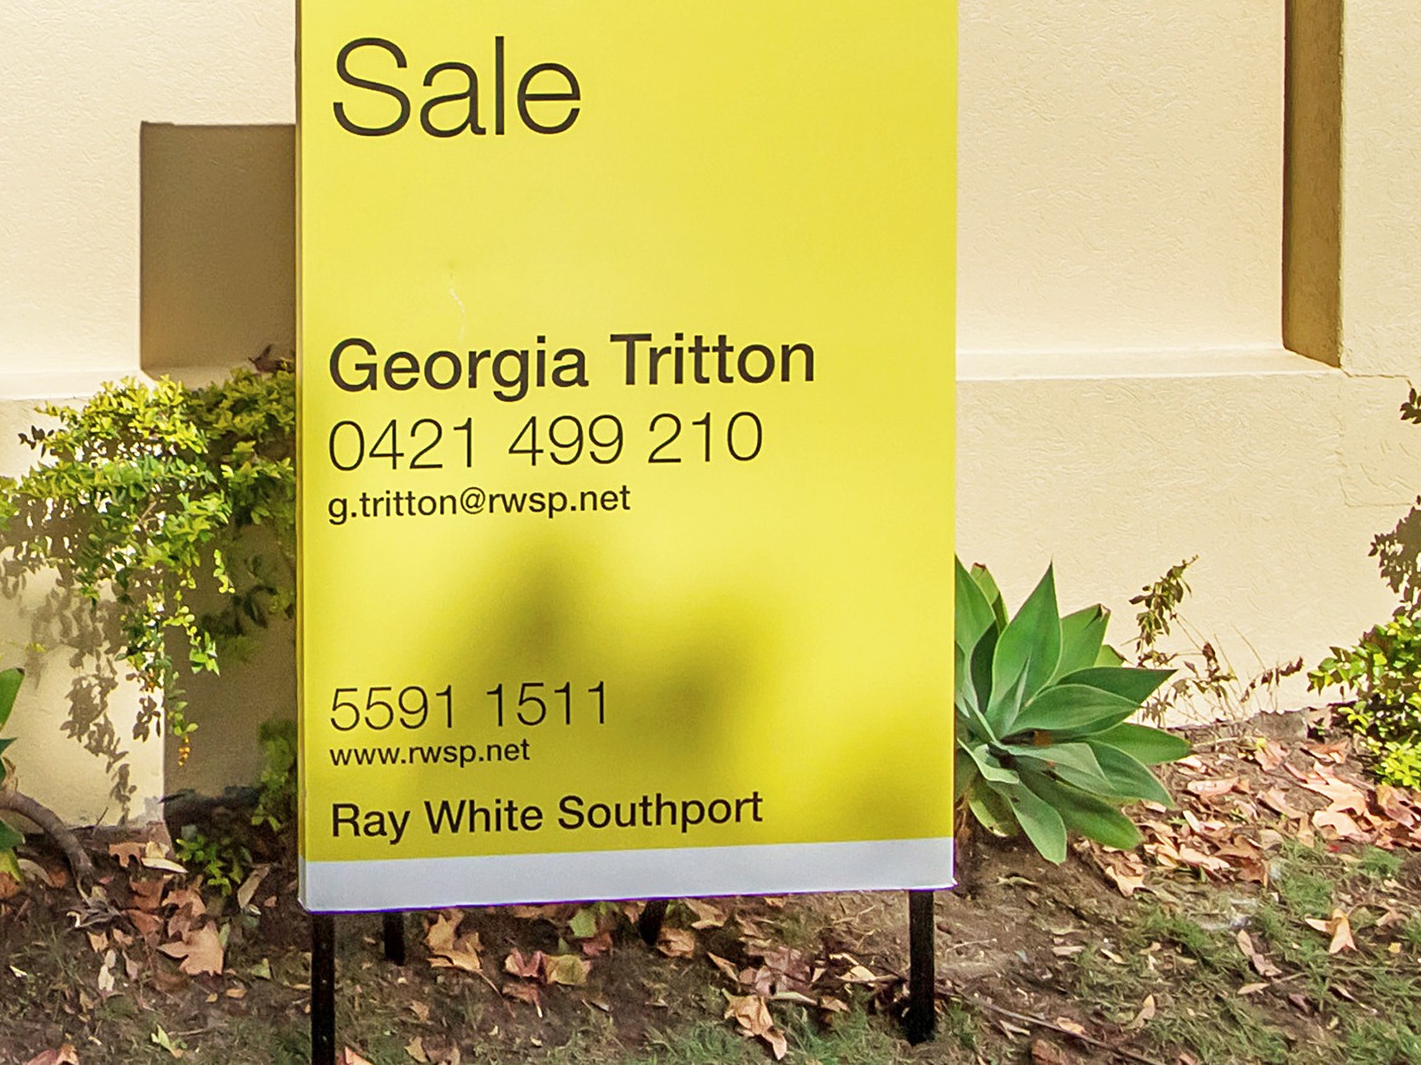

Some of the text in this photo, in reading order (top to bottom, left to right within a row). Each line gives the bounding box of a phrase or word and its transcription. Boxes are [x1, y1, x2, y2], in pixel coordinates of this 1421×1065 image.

[332, 35, 581, 138] Sale
[329, 332, 815, 403] Georgia Tritton
[328, 411, 763, 472] 0421 499 210
[328, 484, 631, 526] g.tritton@rwsp.net
[330, 680, 605, 732] 5591 1511
[329, 738, 531, 769] www.rwsp.net
[332, 791, 764, 846] Ray White Southport
